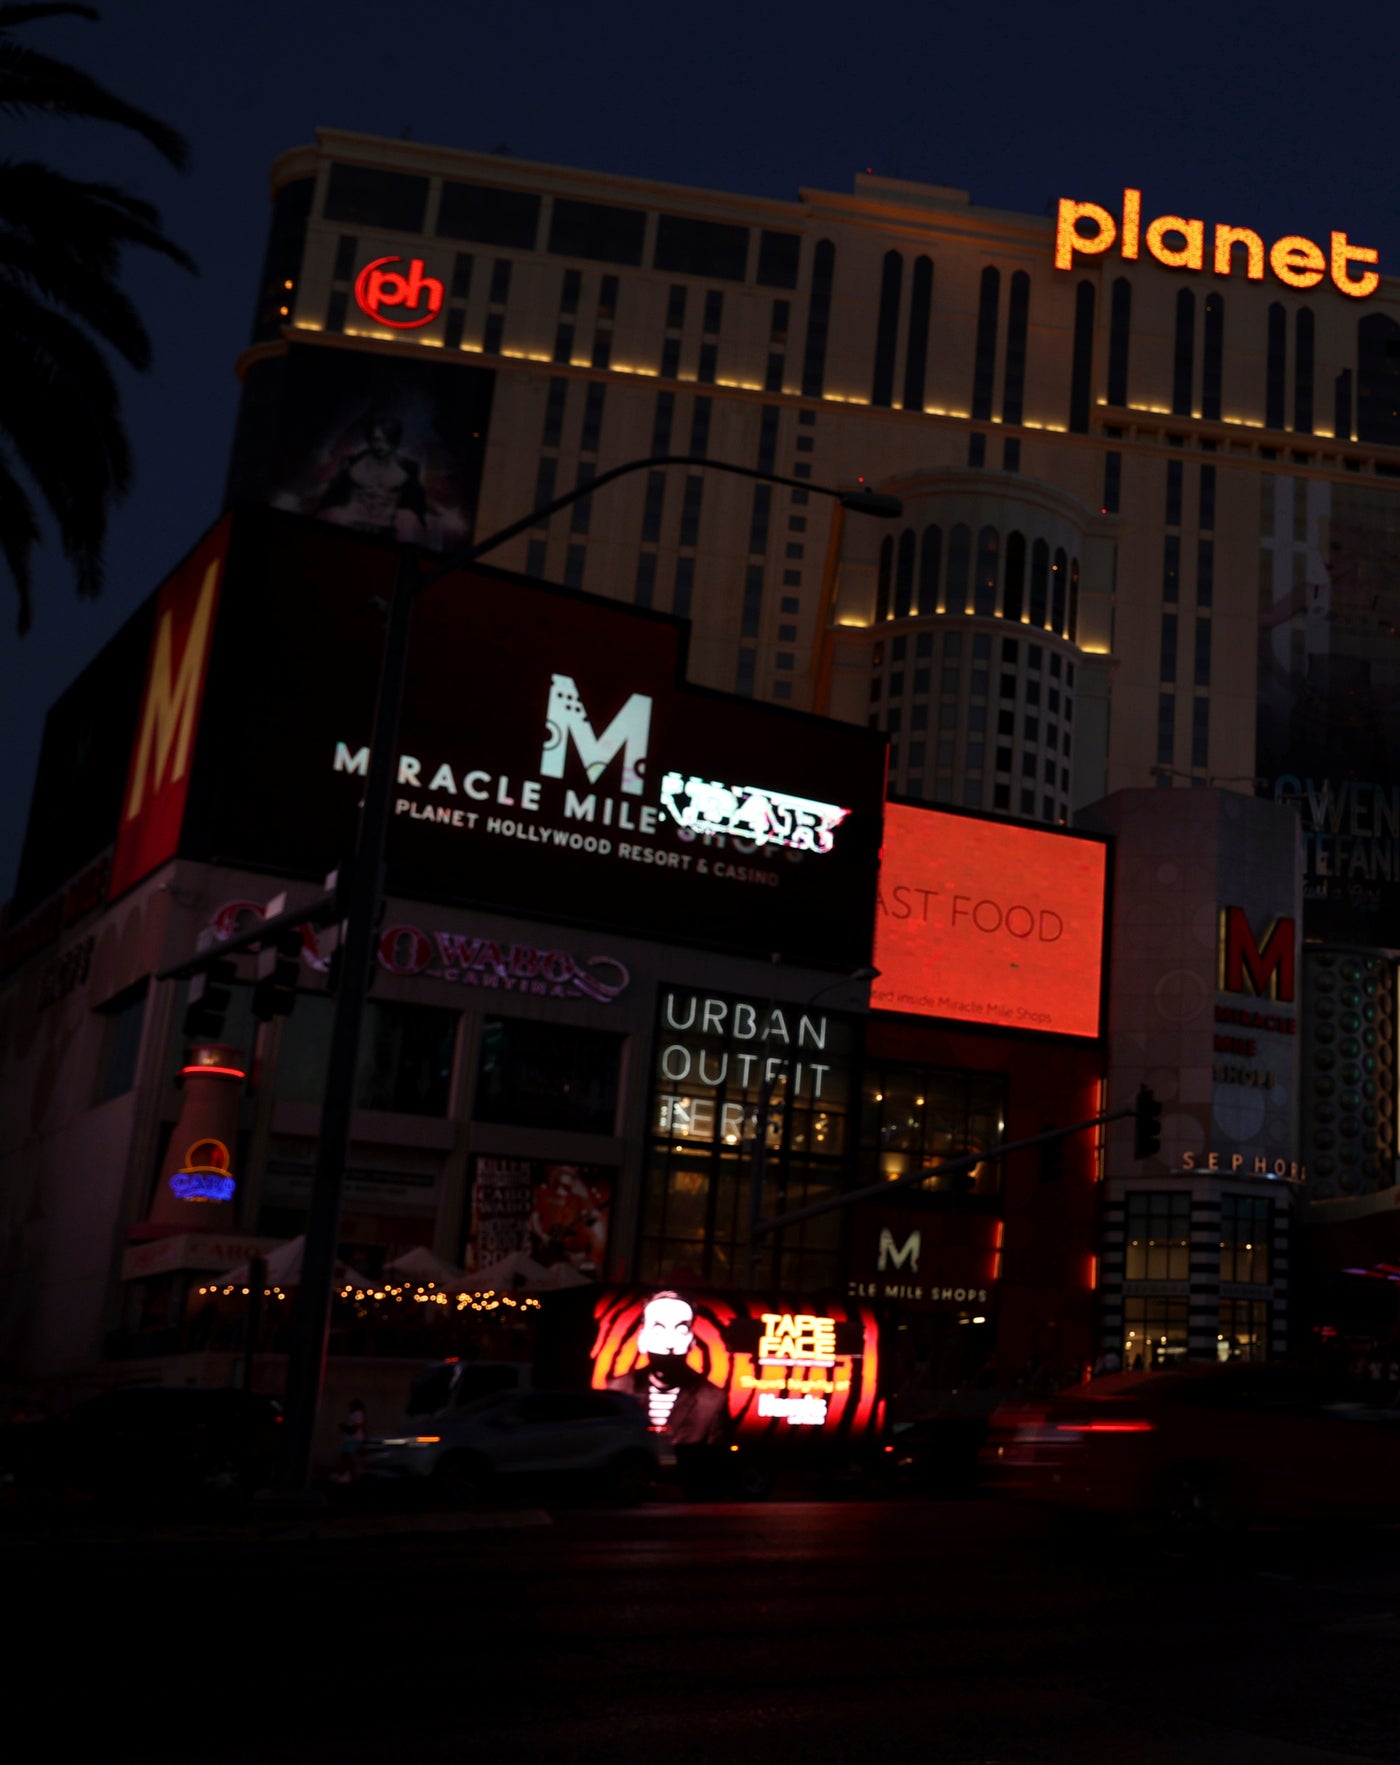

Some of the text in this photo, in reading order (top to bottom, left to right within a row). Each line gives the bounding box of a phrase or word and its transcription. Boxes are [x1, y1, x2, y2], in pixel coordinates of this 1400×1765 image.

[1054, 187, 1379, 297] planet
[366, 258, 445, 313] ph
[126, 556, 222, 822] M
[540, 672, 653, 797] M
[332, 739, 543, 813] MRACLE
[563, 788, 659, 836] MILE
[394, 798, 480, 830] PLANET
[486, 815, 613, 857] HOLLYWOOD
[617, 842, 694, 873] RESORT
[695, 857, 712, 877] &
[712, 860, 781, 889] CASINO
[1302, 830, 1400, 883] TEFANI
[951, 894, 1064, 943] FOOD
[1219, 905, 1296, 1002] M
[665, 991, 828, 1050] URBAN
[661, 1044, 832, 1098] OUTFIT
[885, 1284, 924, 1301] MILE
[930, 1286, 988, 1304] SHOPS
[758, 1335, 837, 1361] FACE
[761, 1313, 837, 1340] TAPE
